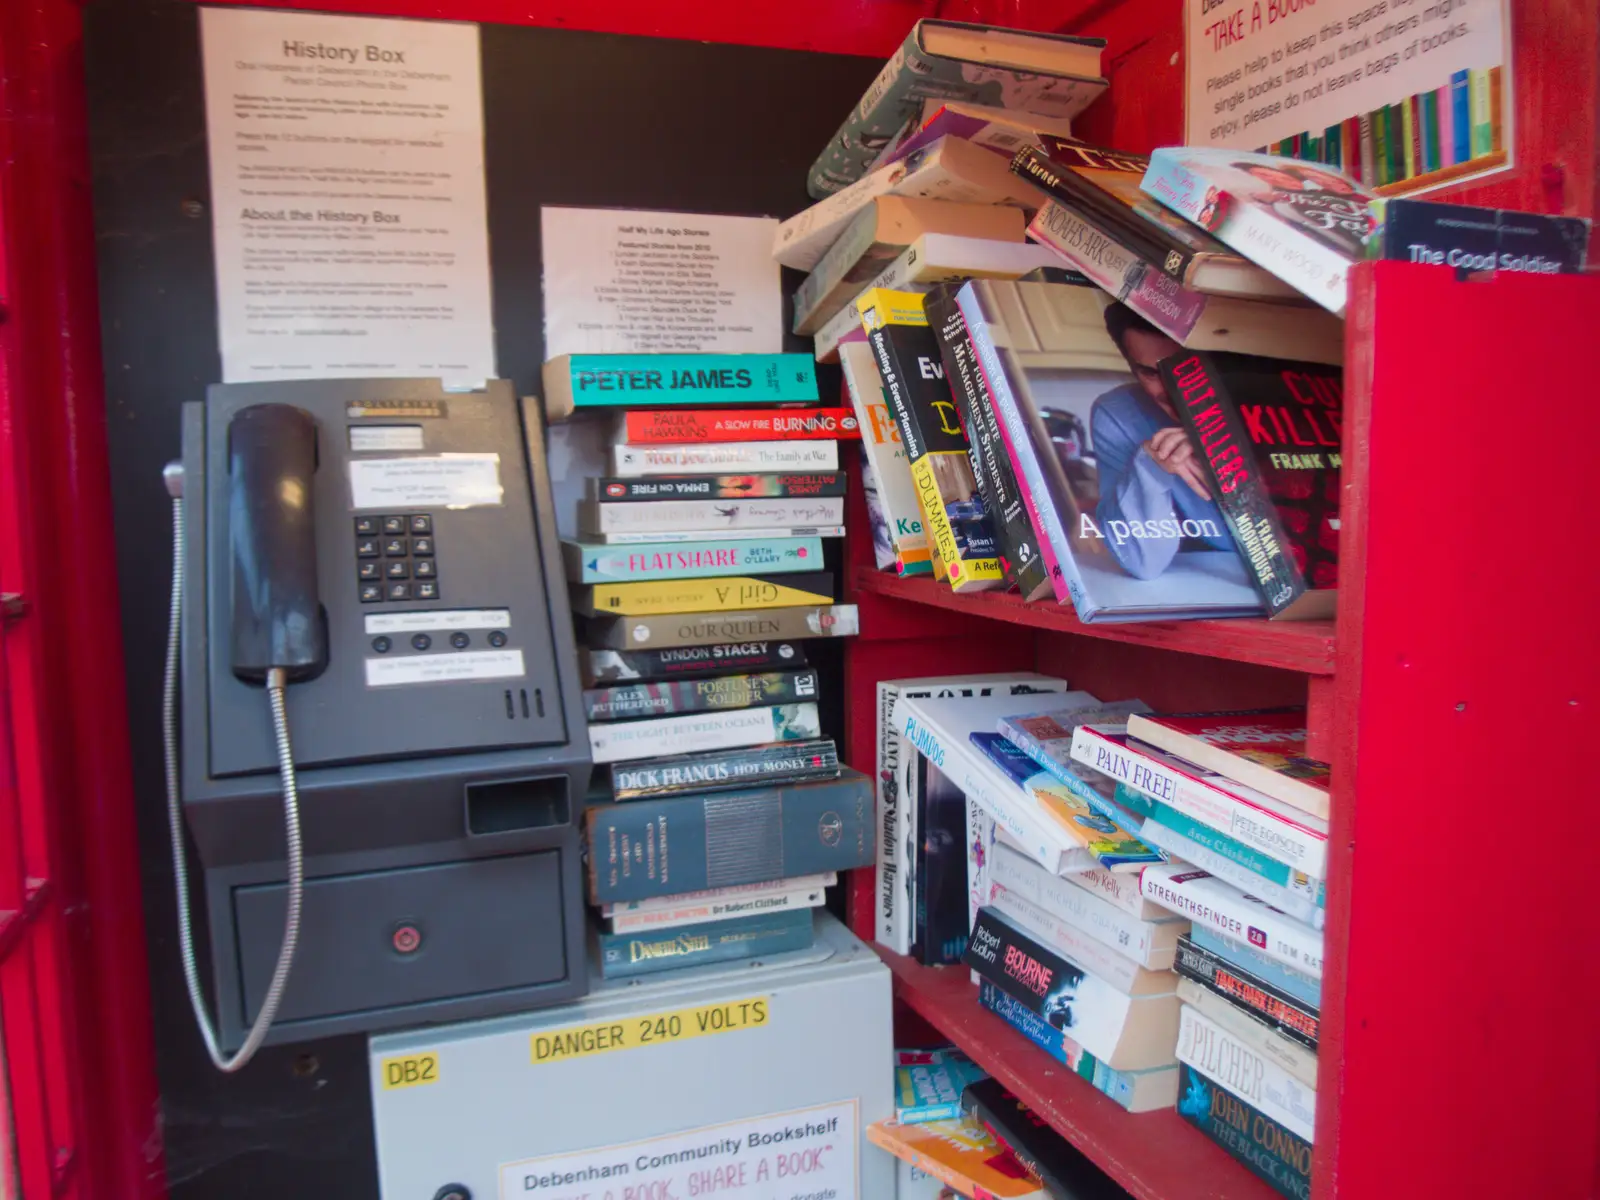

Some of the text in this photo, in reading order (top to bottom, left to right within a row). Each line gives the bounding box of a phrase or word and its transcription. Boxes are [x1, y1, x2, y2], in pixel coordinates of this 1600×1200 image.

[1251, 3, 1262, 26] A
[282, 40, 406, 64] History Box
[1206, 2, 1389, 93] Please help to keep this space
[1213, 89, 1245, 115] single
[1247, 76, 1283, 99] books
[1284, 64, 1309, 84] that
[1312, 52, 1335, 76] you
[1337, 36, 1372, 61] think
[1374, 15, 1420, 44] others
[1243, 101, 1281, 129] please
[1283, 91, 1300, 110] do
[1303, 83, 1325, 103] not
[1326, 67, 1363, 95] leave
[1366, 51, 1399, 78] bags
[1402, 39, 1419, 61] of
[1025, 156, 1059, 188] Turner
[241, 208, 400, 224] About the History Box
[666, 228, 681, 237] Ago
[1245, 225, 1279, 254] MARY
[1082, 231, 1109, 266] ARK
[1408, 244, 1563, 274] The Good Soldier
[1138, 284, 1182, 321] MORRISON
[579, 368, 752, 391] PETER JAMES
[965, 338, 1001, 443] LAW FOR ESTATE
[874, 332, 918, 458] Meeting & Event Planning
[643, 426, 709, 438] HAWKINS
[653, 413, 697, 426] PAULA
[715, 417, 836, 431] A SLOW FIRE BURNING
[953, 343, 1006, 504] MANAGEMENT STUDENTS
[1172, 355, 1249, 495] CULT KILLERS
[760, 450, 827, 464] The Family at War
[1269, 453, 1325, 470] FRANK
[632, 483, 709, 494] EMMA ON FIRE
[776, 476, 835, 485] PATTERSON
[788, 485, 822, 494] JAMES
[919, 473, 955, 563] DUMMIES
[1079, 513, 1223, 545] A passion
[967, 537, 987, 546] Susan
[1235, 512, 1275, 585] MOORHOUSE
[1255, 518, 1281, 559] FRANK
[629, 547, 741, 573] FLATSHARE
[745, 554, 780, 565] O'LEARY
[749, 548, 773, 556] BETH
[974, 561, 982, 571] A
[715, 584, 779, 604] Girl A
[678, 620, 781, 643] OUR QUEEN
[660, 642, 769, 662] LYNDON STACEY
[615, 691, 644, 701] ALEX
[697, 677, 771, 696] FORTUNE'S
[706, 690, 763, 706] SOLDIER
[592, 698, 669, 713] RUTHERFORD
[904, 717, 944, 767] PLUMDOG
[618, 764, 729, 790] DICK FRANCIS
[733, 759, 806, 775] HOT MONEY
[1095, 747, 1173, 800] PAIN FREE
[1235, 814, 1259, 835] PETE
[1101, 875, 1121, 900] Kelly
[712, 896, 788, 914] Dr Robert Clifford
[1147, 882, 1242, 935] STRENGTHSFINDER
[977, 924, 1001, 949] Robert
[971, 941, 997, 963] Ludlum
[1276, 940, 1298, 959] TOM
[1005, 943, 1053, 989] BOURNE
[535, 1001, 767, 1060] DANGER 240 VOLTS
[388, 1056, 436, 1087] DB2
[1190, 1018, 1265, 1103] PILCHER
[1208, 1087, 1249, 1137] JOHN
[523, 1116, 839, 1191] Debenham Community Bookshelf
[1212, 1118, 1278, 1176] THE BLACK
[686, 1158, 769, 1197] SHARE A
